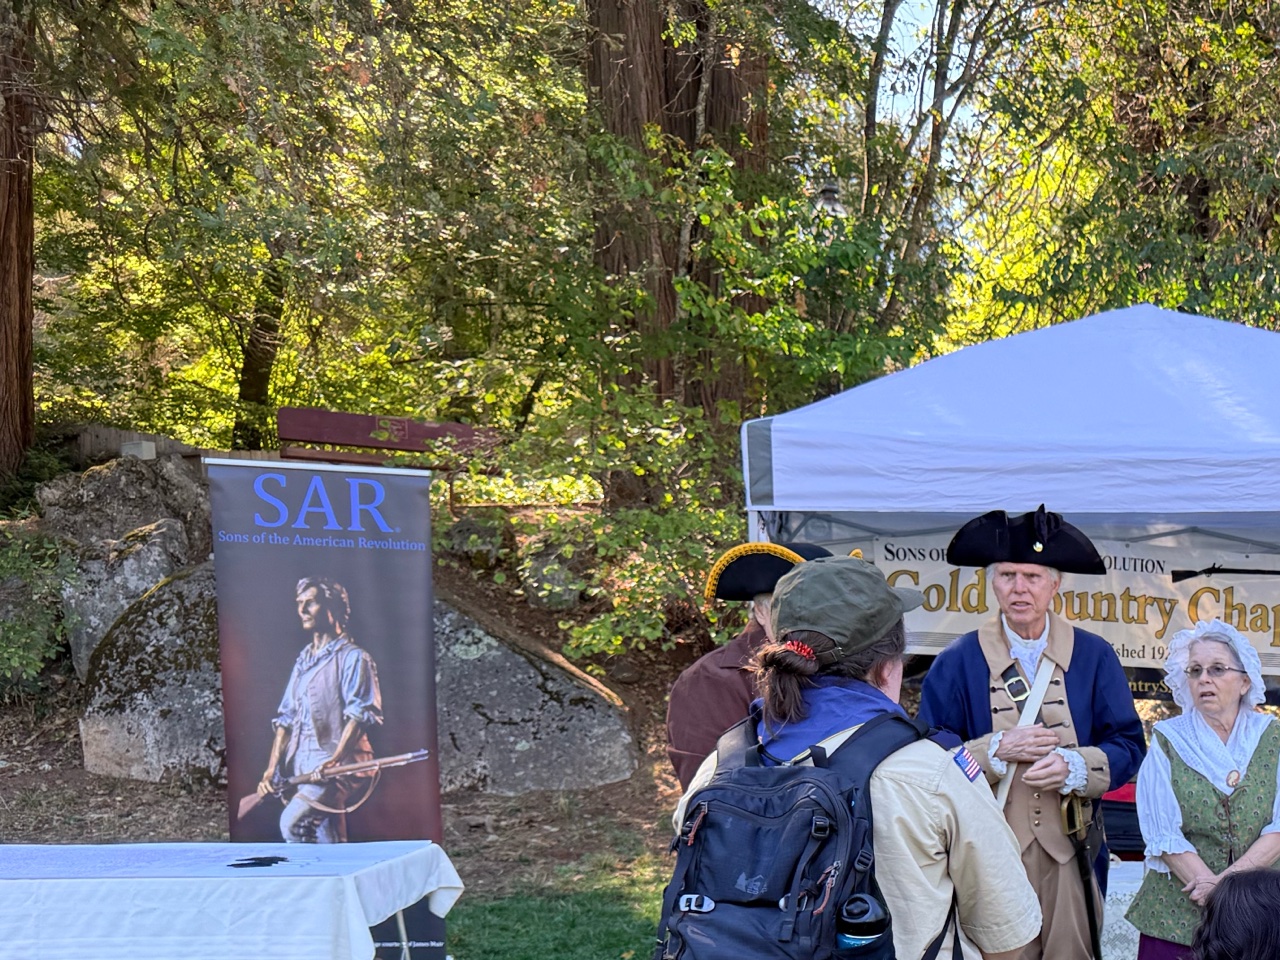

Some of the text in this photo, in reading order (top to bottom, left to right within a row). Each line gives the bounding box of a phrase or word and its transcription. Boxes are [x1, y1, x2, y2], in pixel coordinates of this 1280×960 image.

[218, 530, 426, 551] Sons of the American Revolution
[1102, 554, 1167, 575] OLUTION
[1051, 586, 1179, 640] untry
